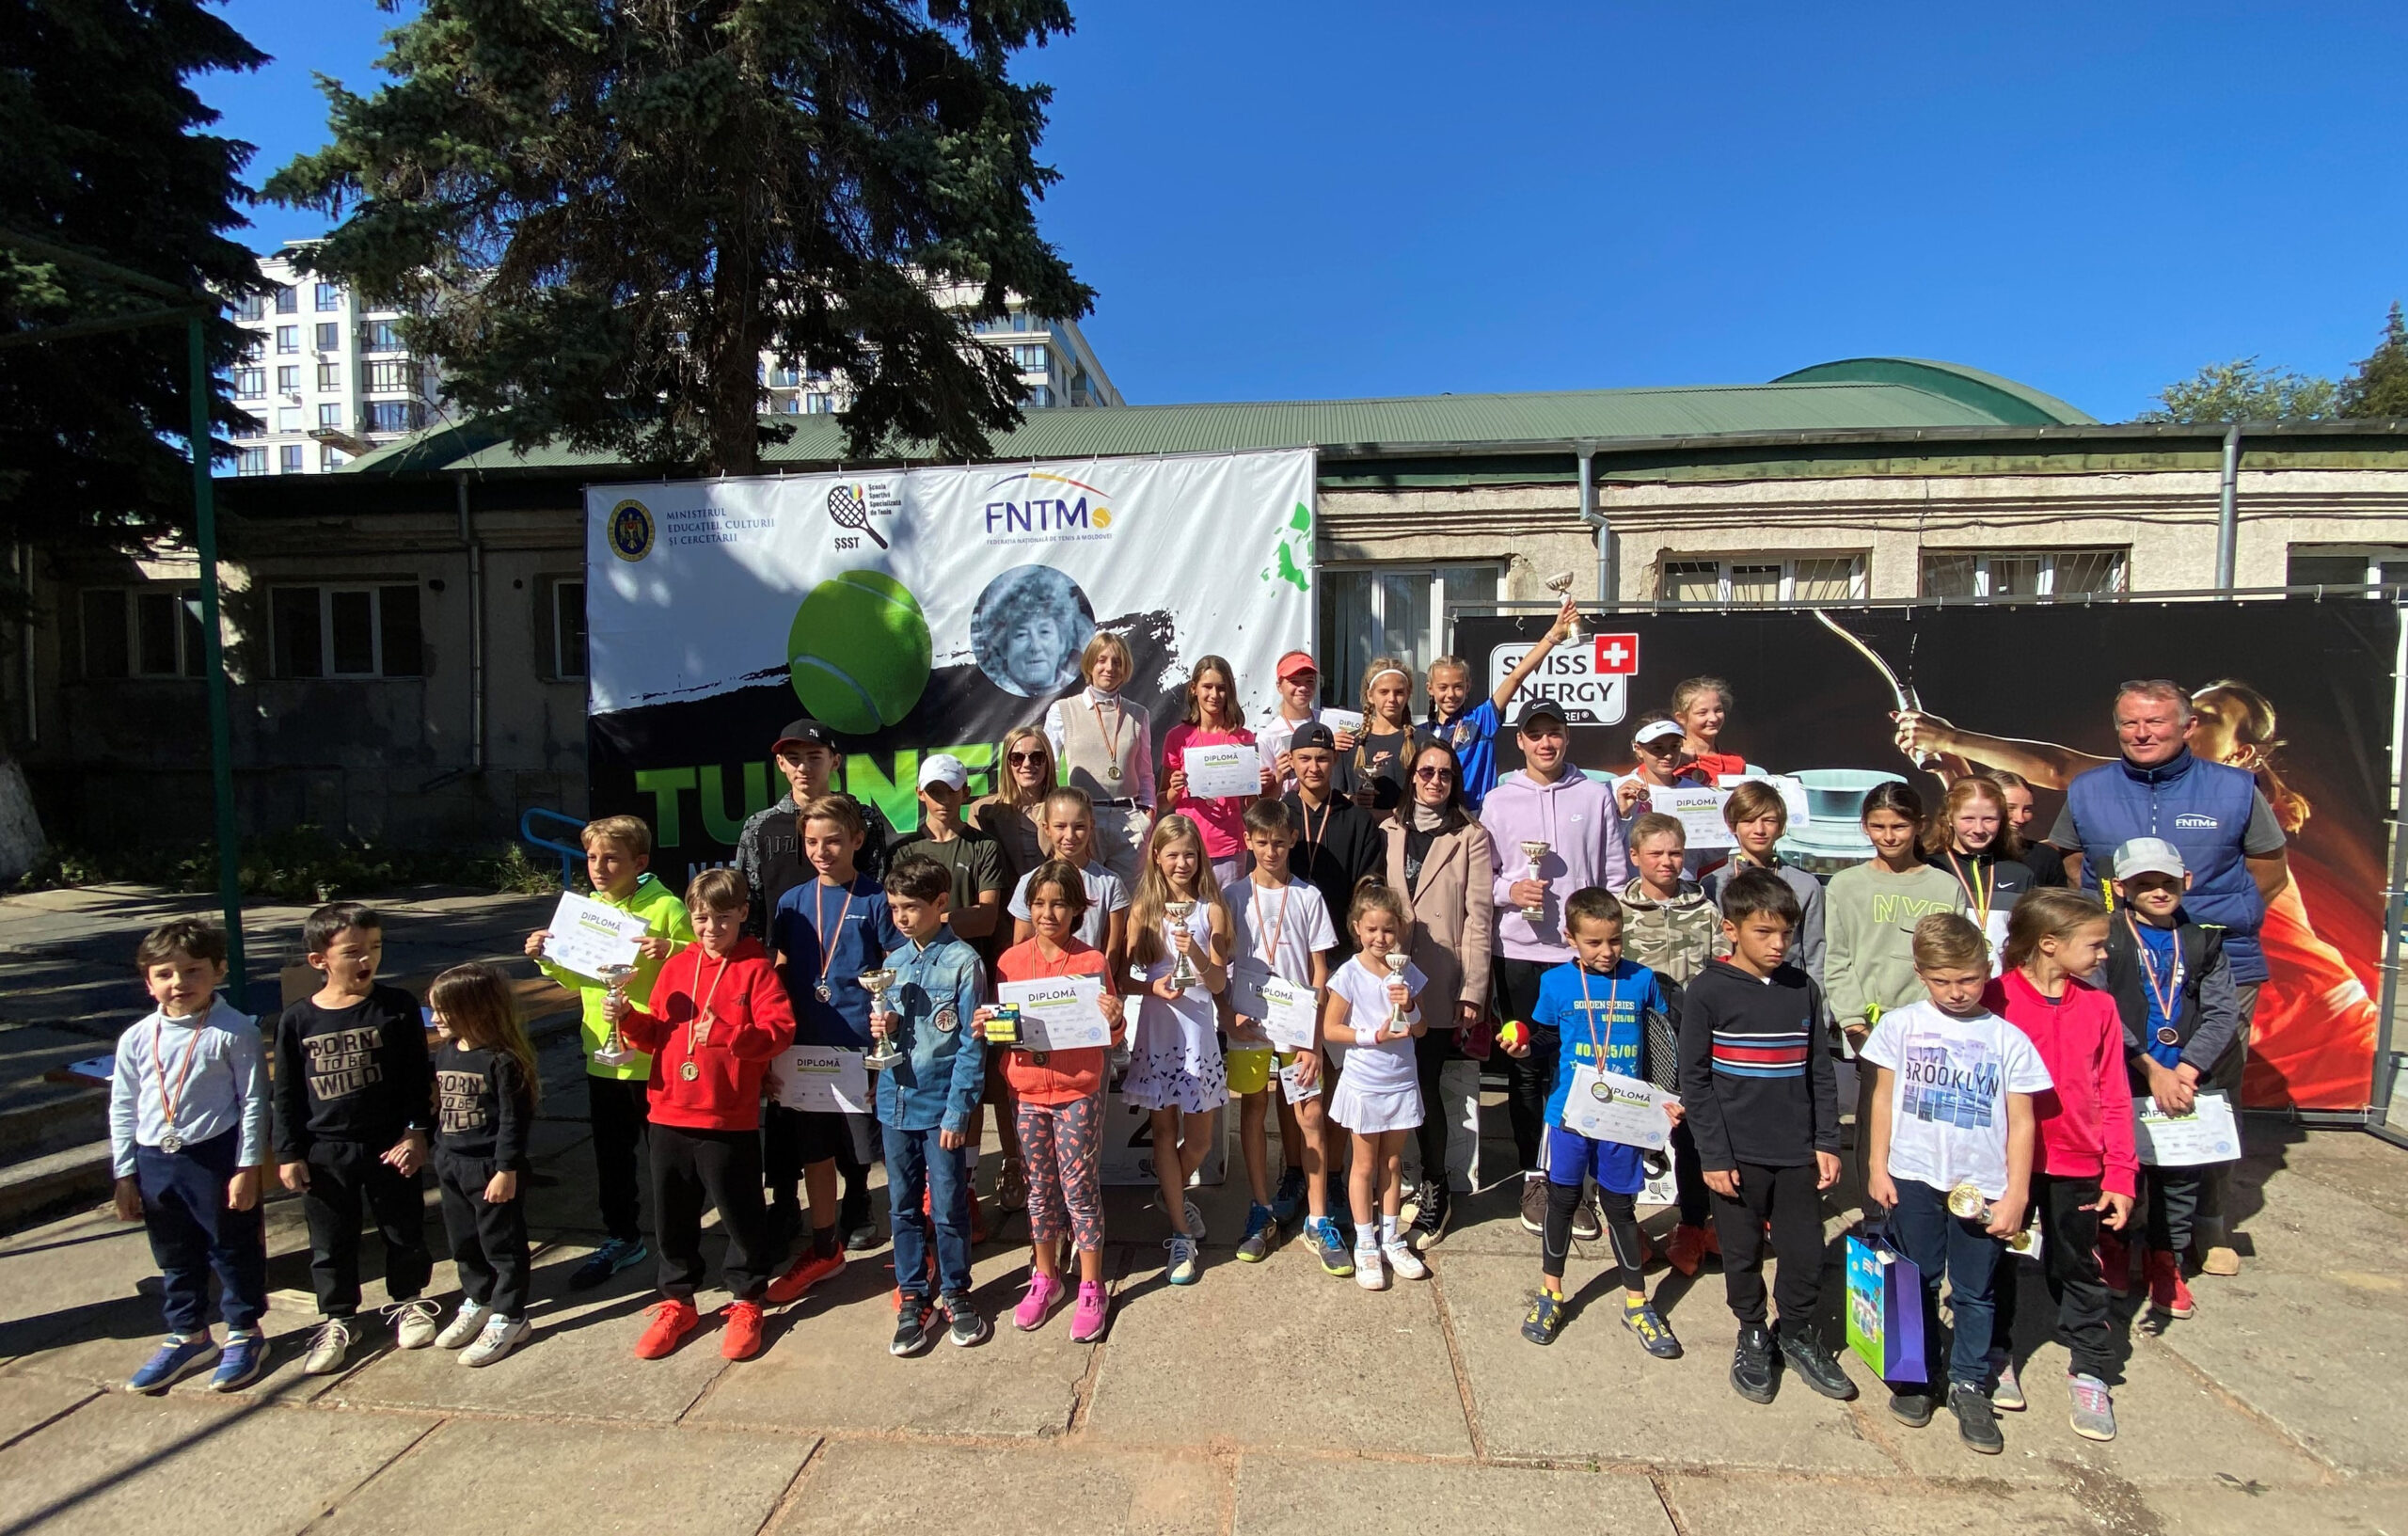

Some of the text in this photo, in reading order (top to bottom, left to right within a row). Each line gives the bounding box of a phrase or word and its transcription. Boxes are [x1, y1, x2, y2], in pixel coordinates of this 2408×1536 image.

[667, 508, 727, 520] MINISTERUL
[986, 497, 1088, 533] FNTM
[725, 519, 774, 530] CULTURII
[669, 532, 737, 546] ȘI CERCETĂRII
[835, 537, 860, 552] ȘSST
[1510, 682, 1614, 703] NERGY
[1339, 720, 1361, 729] DIPLO
[1204, 752, 1239, 762] DIPLOMĂ
[1677, 797, 1718, 807] DIPLOMĂ
[2176, 818, 2210, 827] FNTM
[580, 911, 622, 931] DIPLOMĂ
[1028, 987, 1077, 1002] DIPLOMĂ
[1256, 985, 1294, 1002] DIPLOMĂ
[309, 1030, 374, 1056] BORN
[324, 1054, 368, 1071] TO BE
[797, 1057, 840, 1068] DIPLOMĂ
[317, 1067, 379, 1096] WILD
[1906, 1061, 1999, 1097] BROOKLYN
[1609, 1086, 1652, 1102] IPLOMĂ
